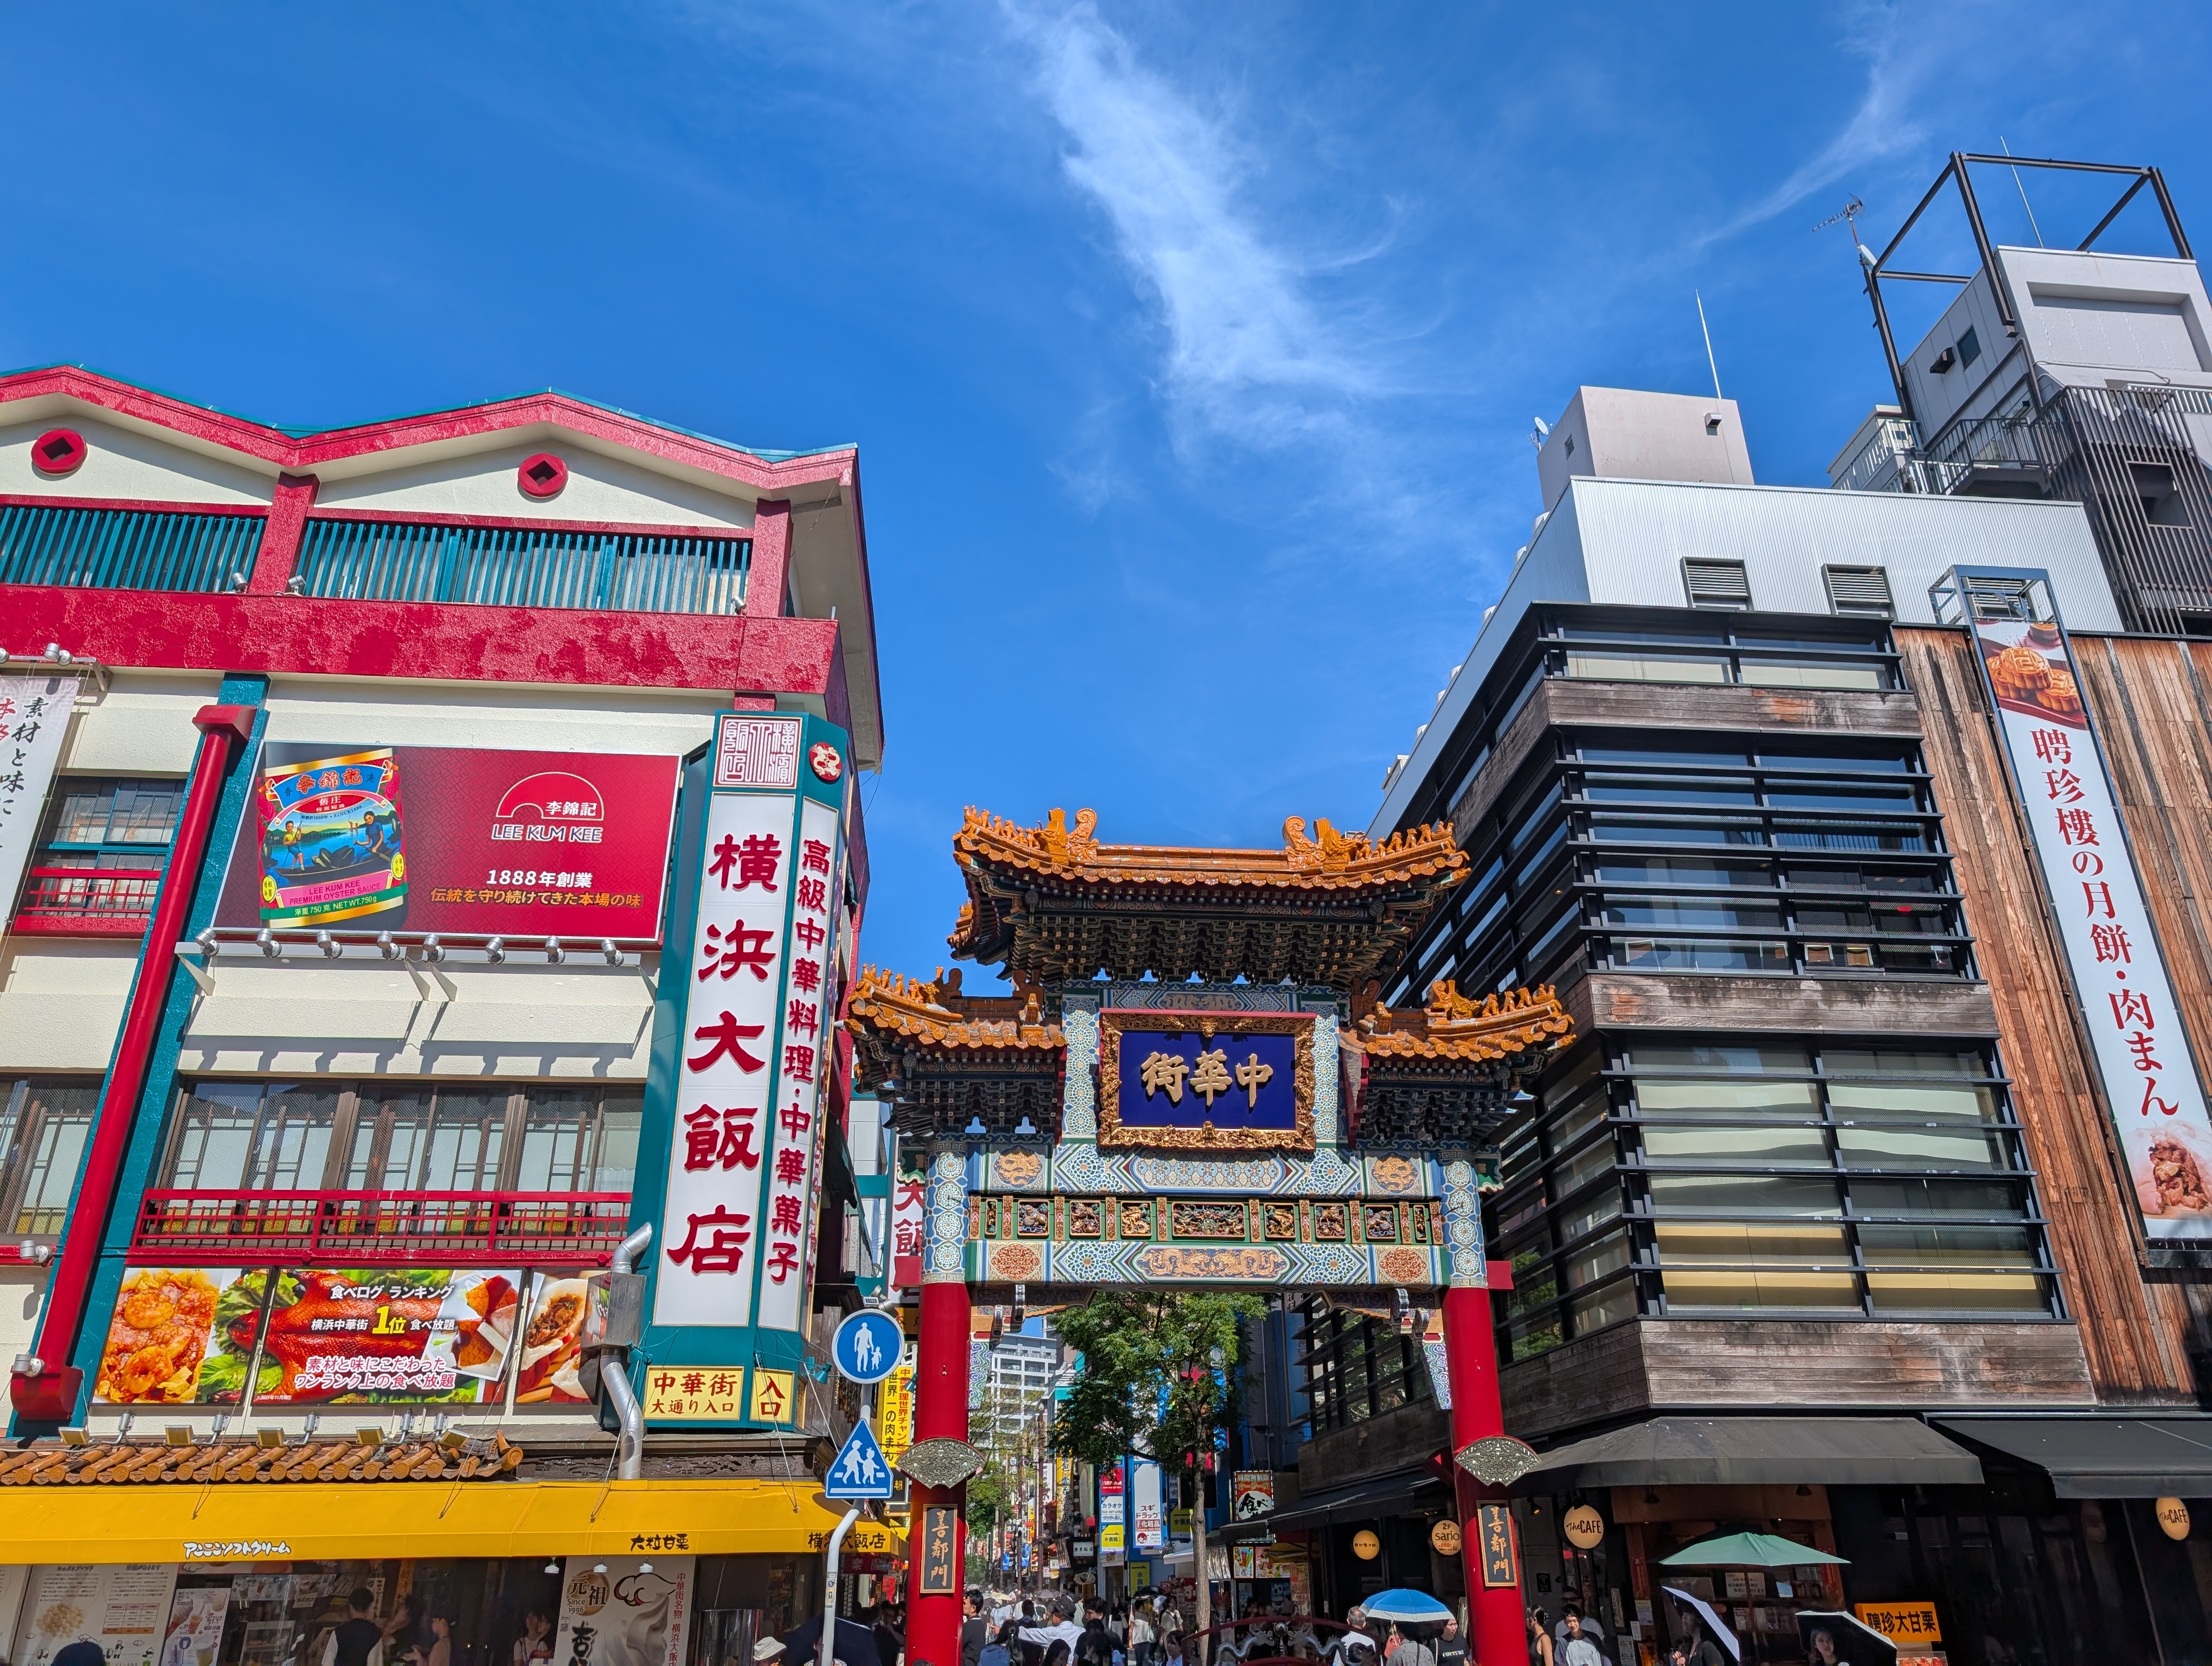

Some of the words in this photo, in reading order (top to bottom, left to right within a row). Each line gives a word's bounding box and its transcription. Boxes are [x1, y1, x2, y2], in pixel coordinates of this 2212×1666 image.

[0, 697, 49, 849] 素材と味に
[545, 801, 597, 816] 李錦記
[492, 824, 523, 840] LEE
[527, 825, 565, 842] KUM
[569, 826, 603, 843] KEE
[309, 886, 324, 895] LEE
[325, 882, 344, 892] KUM
[345, 880, 361, 889] KEE
[486, 869, 593, 888] 1888年創業
[290, 895, 321, 905] PREMIUM
[324, 889, 355, 900] OYSTER
[357, 883, 381, 894] SAUCE
[430, 888, 641, 908] 伝統を守り続けてきた本場の味
[333, 901, 348, 909] NET
[666, 833, 782, 1275] 横浜大飯店
[767, 838, 831, 1284] 高級中華料理・中華菓子
[893, 1181, 923, 1296] 大飯
[330, 1285, 384, 1300] 食べログ
[389, 1285, 454, 1299] ランキング
[311, 1318, 368, 1331] 横浜中華街
[372, 1305, 406, 1335] 1位
[305, 1355, 447, 1373] 素材と味にこだわった
[294, 1373, 456, 1391] ワンランク上の食べ放題
[654, 1372, 738, 1397] 中華街
[758, 1375, 786, 1417] 入口
[650, 1398, 734, 1414] 大通り入口
[1140, 1504, 1156, 1512] スギ
[1238, 1492, 1269, 1516] 食べ
[2169, 1509, 2189, 1523] CAFE
[1435, 1530, 1460, 1541] sario
[1580, 1520, 1602, 1534] CAFE
[183, 1540, 292, 1559] アンニンソフトクリーム
[630, 1533, 690, 1551] 大粒甘栗
[567, 1574, 607, 1606] 元祖
[672, 1572, 686, 1619] 中華街名物
[567, 1598, 586, 1606] Since
[568, 1606, 584, 1614] 1996
[1866, 1610, 1938, 1634] 聘珍大甘栗
